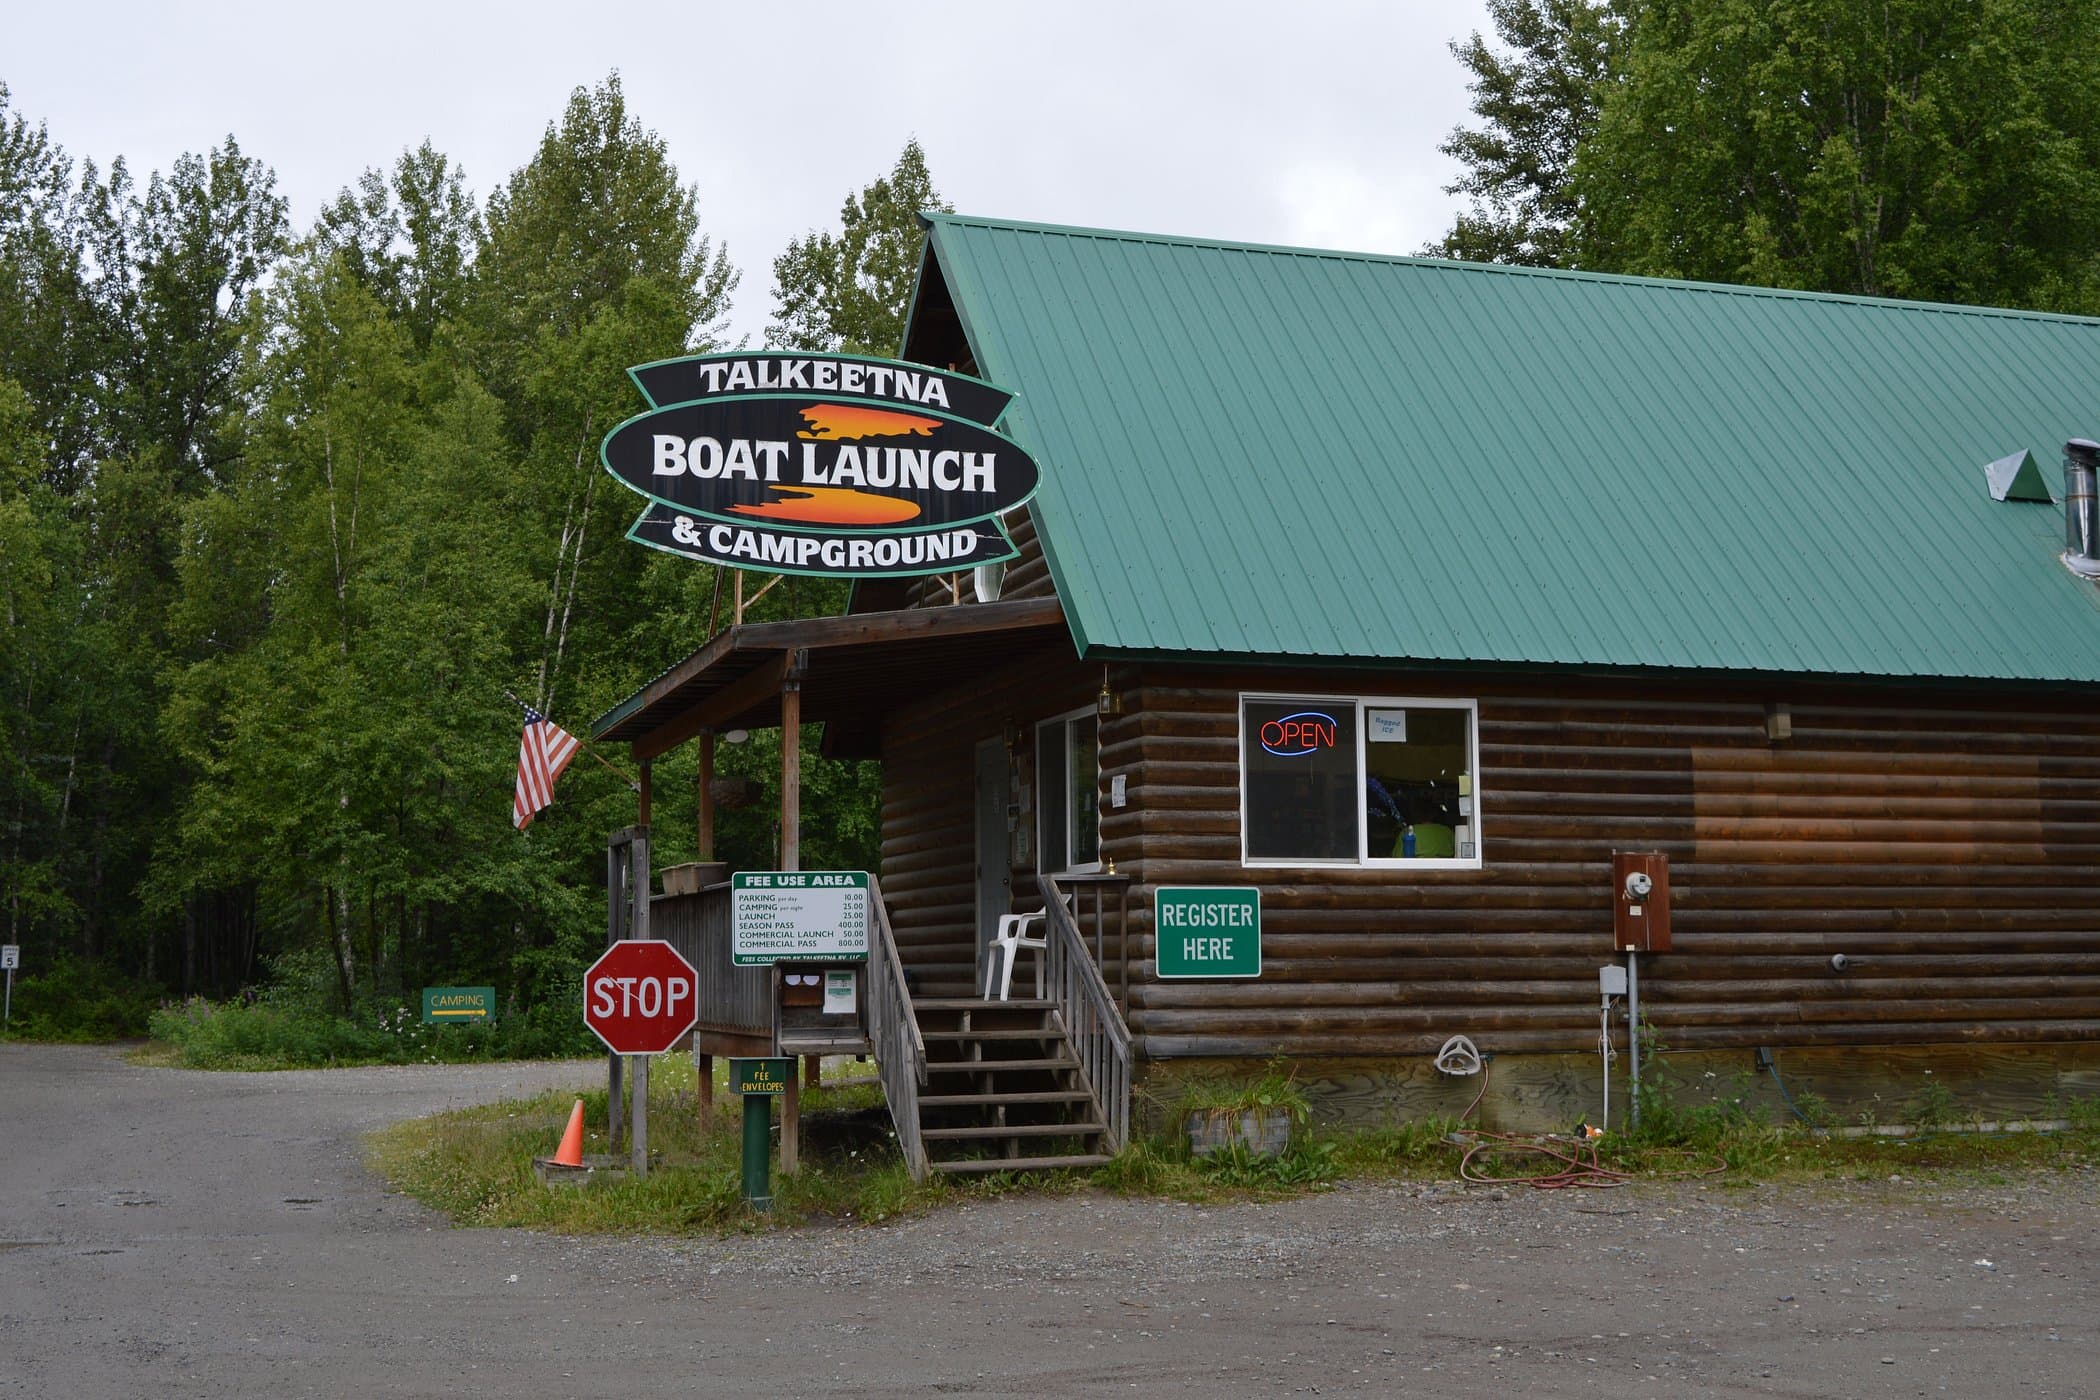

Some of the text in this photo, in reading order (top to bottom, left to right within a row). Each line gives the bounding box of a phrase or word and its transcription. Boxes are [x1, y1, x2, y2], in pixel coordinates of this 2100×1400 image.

[700, 360, 951, 408] TALKEETNA
[652, 434, 997, 493] BOAT LAUNCH
[671, 516, 977, 567] & CAMPGROUND
[1260, 721, 1335, 747] OPEN
[745, 875, 855, 886] FEE USE AREA
[1162, 904, 1253, 926] REGISTER
[1183, 938, 1234, 960] HERE
[431, 995, 484, 1007] CAMPING
[592, 977, 690, 1018] STOP
[742, 1082, 784, 1092] ENVELOPES
[754, 1071, 769, 1081] FEE
